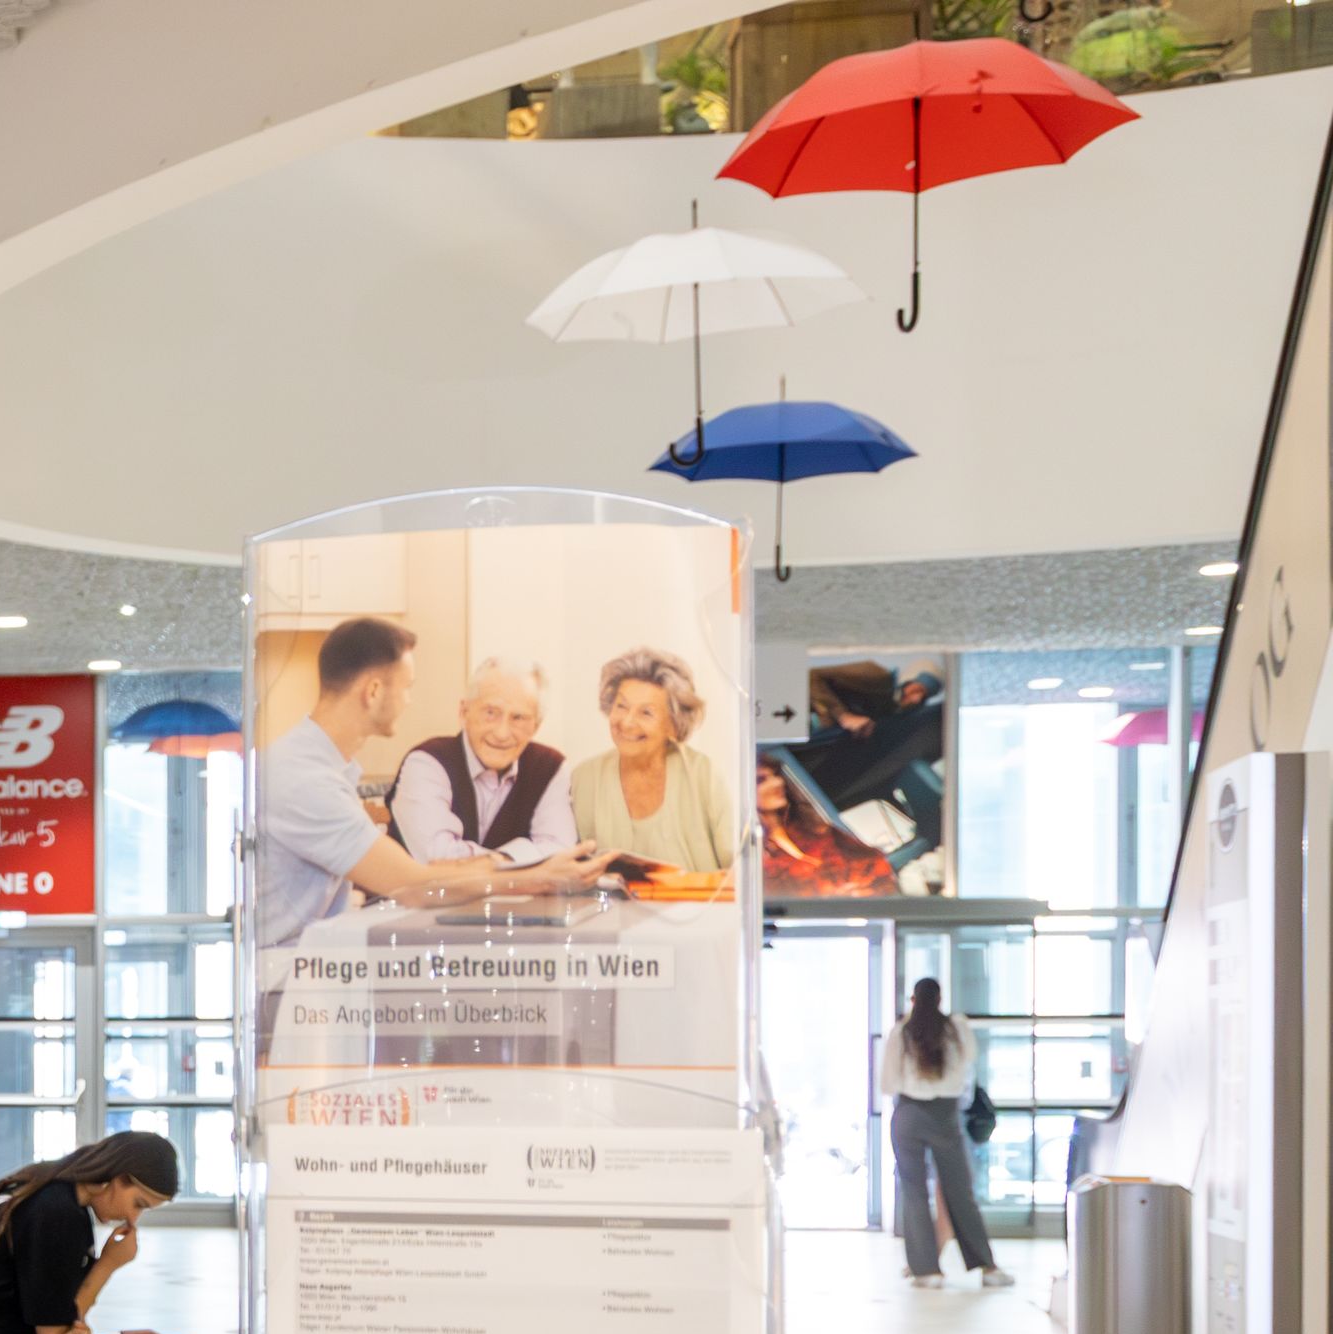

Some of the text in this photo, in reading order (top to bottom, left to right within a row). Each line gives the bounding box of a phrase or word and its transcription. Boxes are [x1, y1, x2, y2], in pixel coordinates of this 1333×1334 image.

[36, 819, 59, 848] 5
[294, 954, 660, 984] Pflege und Betreuung in Wien
[294, 1000, 547, 1028] Das Angebot im Überblick
[310, 1093, 398, 1106] SOZIALES
[295, 1157, 488, 1176] Wohn- und Pflegehäuser
[539, 1157, 589, 1169] WIEN
